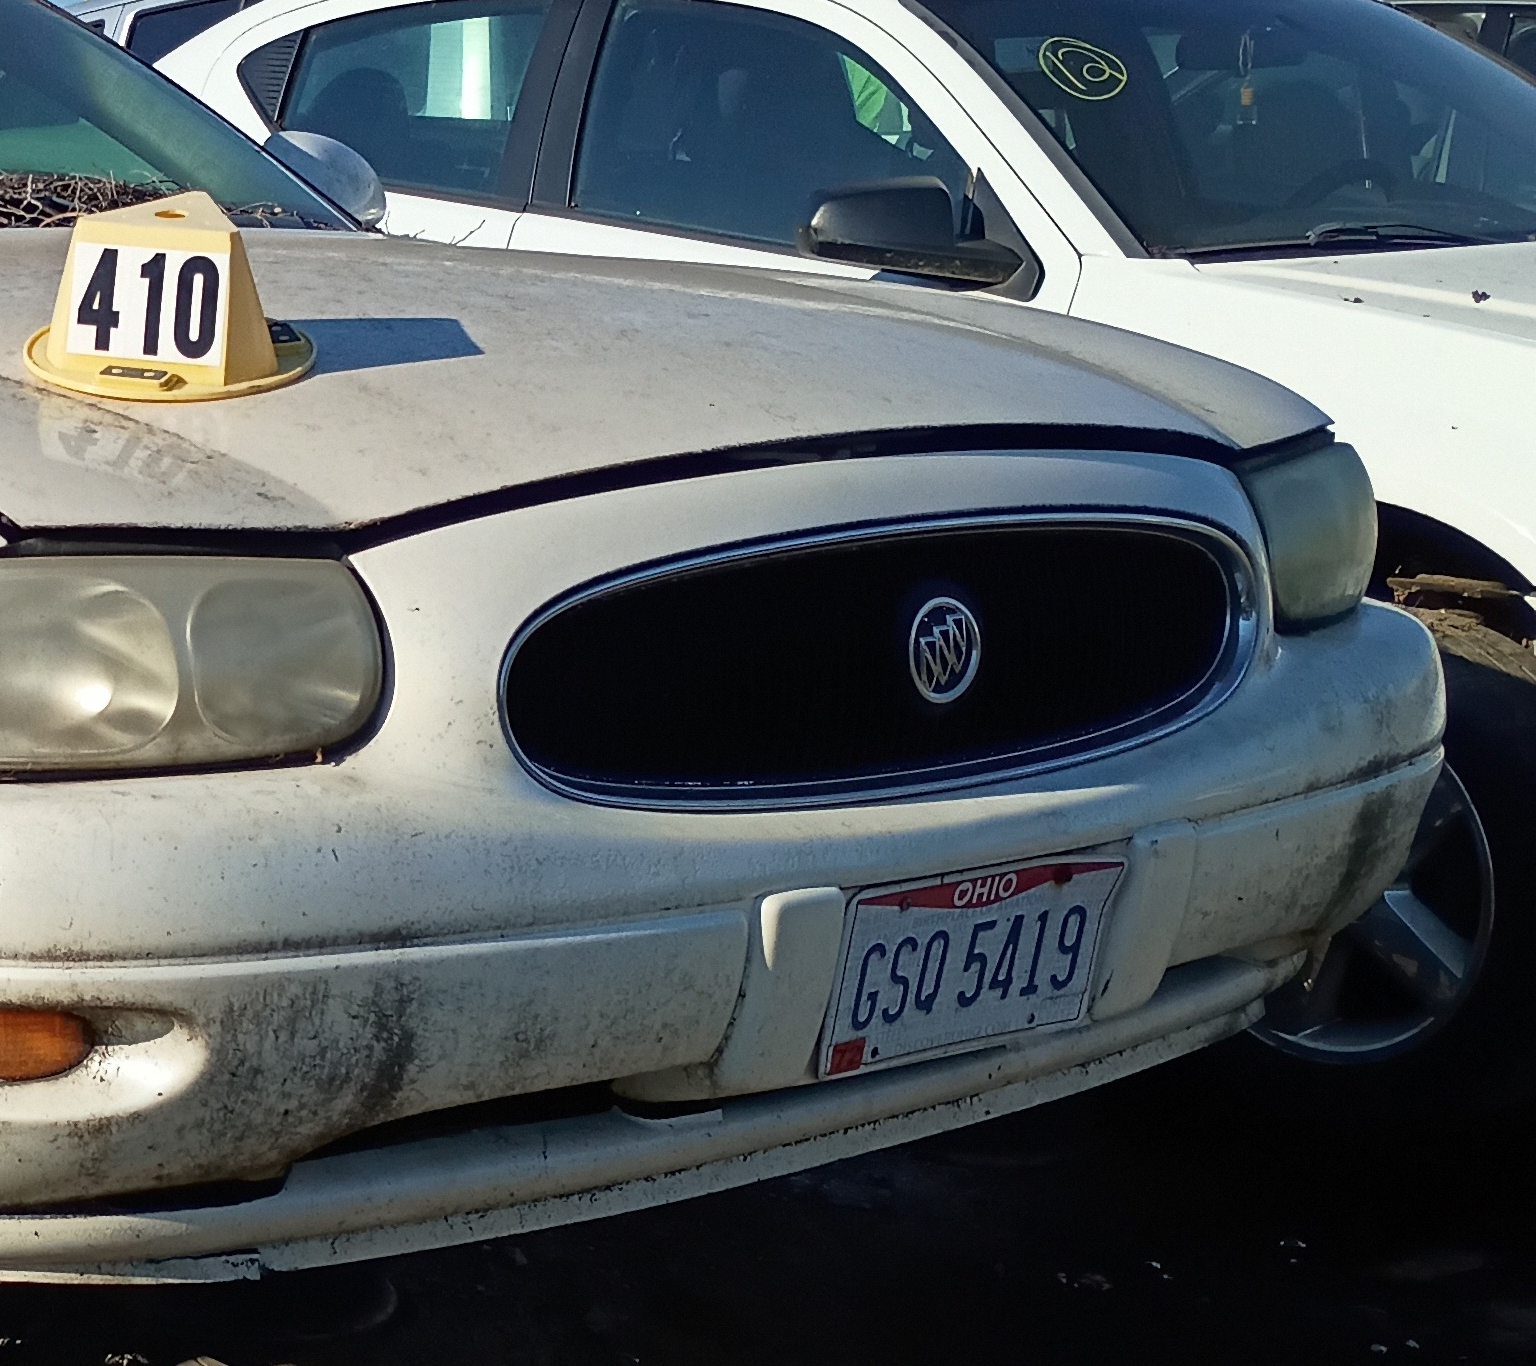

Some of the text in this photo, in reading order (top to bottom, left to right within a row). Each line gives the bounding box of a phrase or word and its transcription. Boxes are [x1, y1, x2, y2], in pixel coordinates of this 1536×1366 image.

[77, 248, 220, 359] 410
[953, 872, 1017, 907] OHIO
[851, 904, 1087, 1031] GSQ 5419
